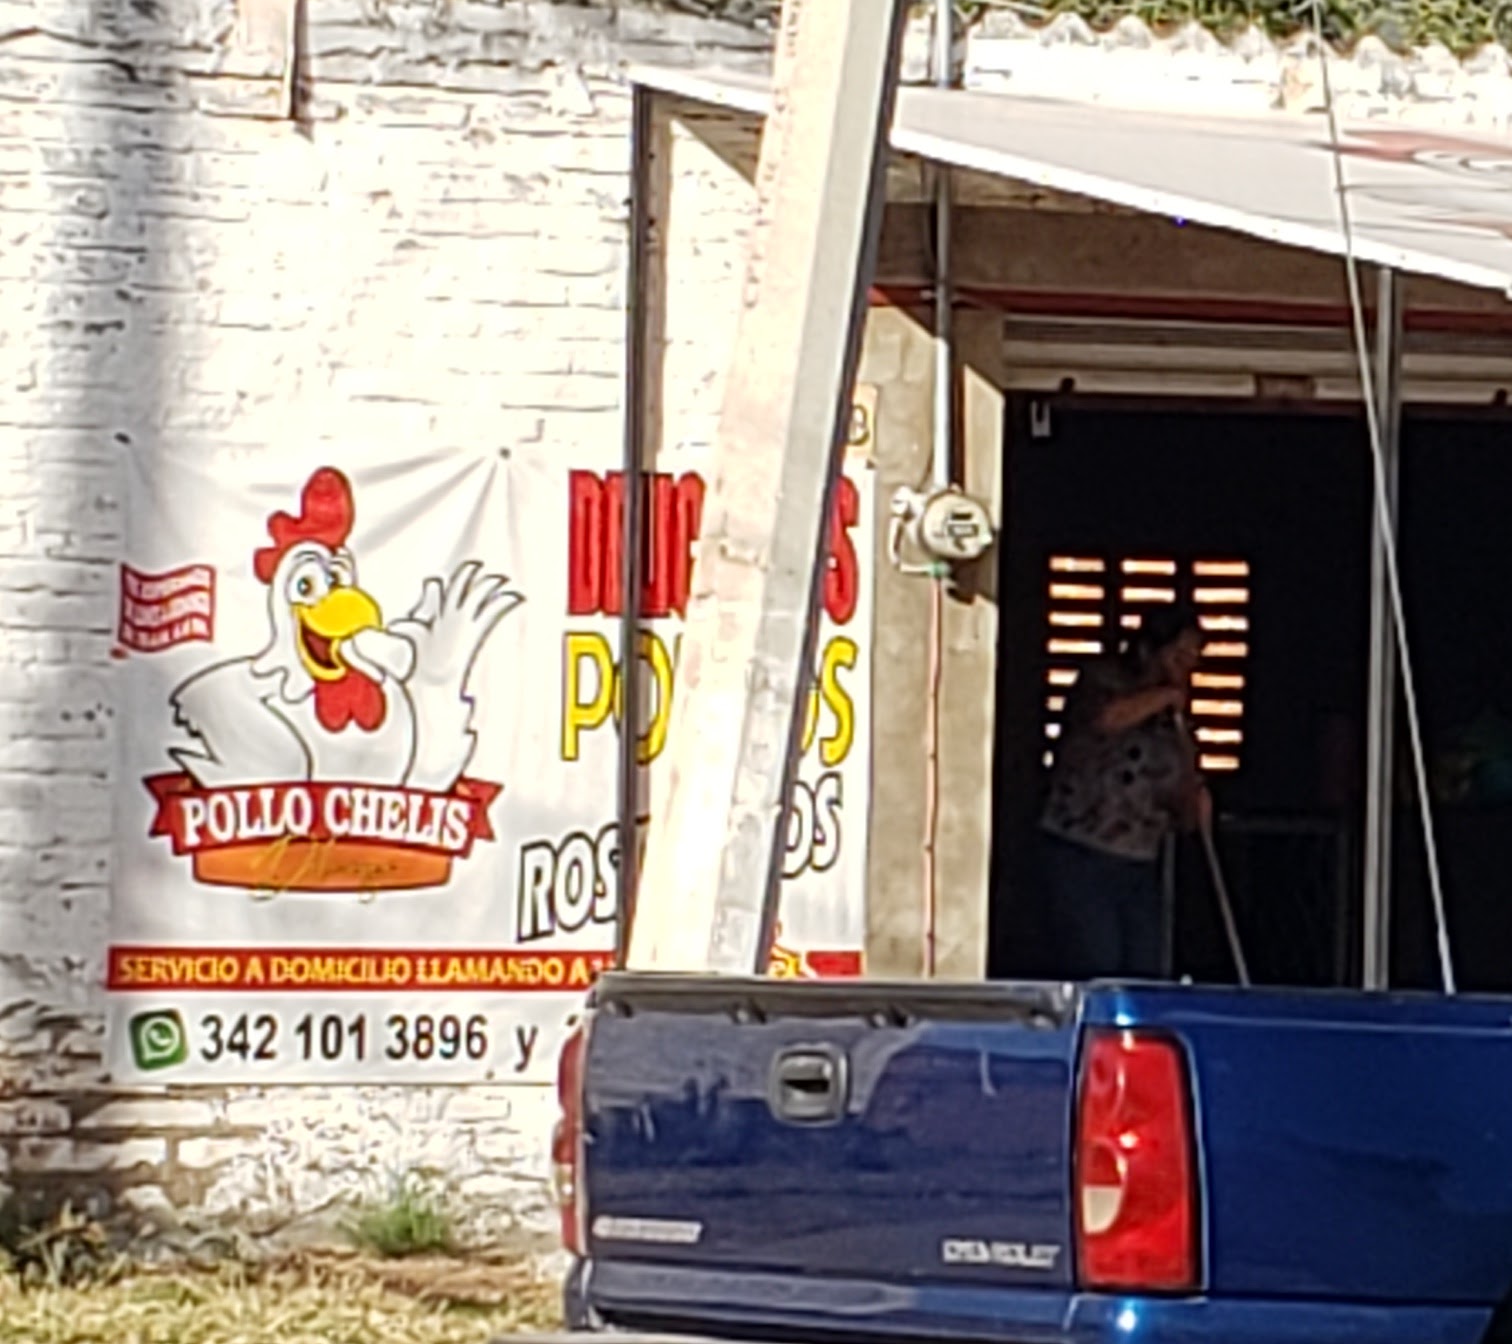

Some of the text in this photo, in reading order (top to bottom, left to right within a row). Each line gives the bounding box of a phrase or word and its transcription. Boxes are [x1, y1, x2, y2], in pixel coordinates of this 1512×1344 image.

[180, 787, 472, 851] POLLO CHELIS
[119, 956, 239, 983] SERVICIO
[245, 956, 265, 983] A
[270, 956, 411, 984] DOMICILIO
[416, 957, 563, 984] LLAMANDO
[569, 958, 589, 984] A
[201, 1013, 538, 1073] 342 101 3896 y
